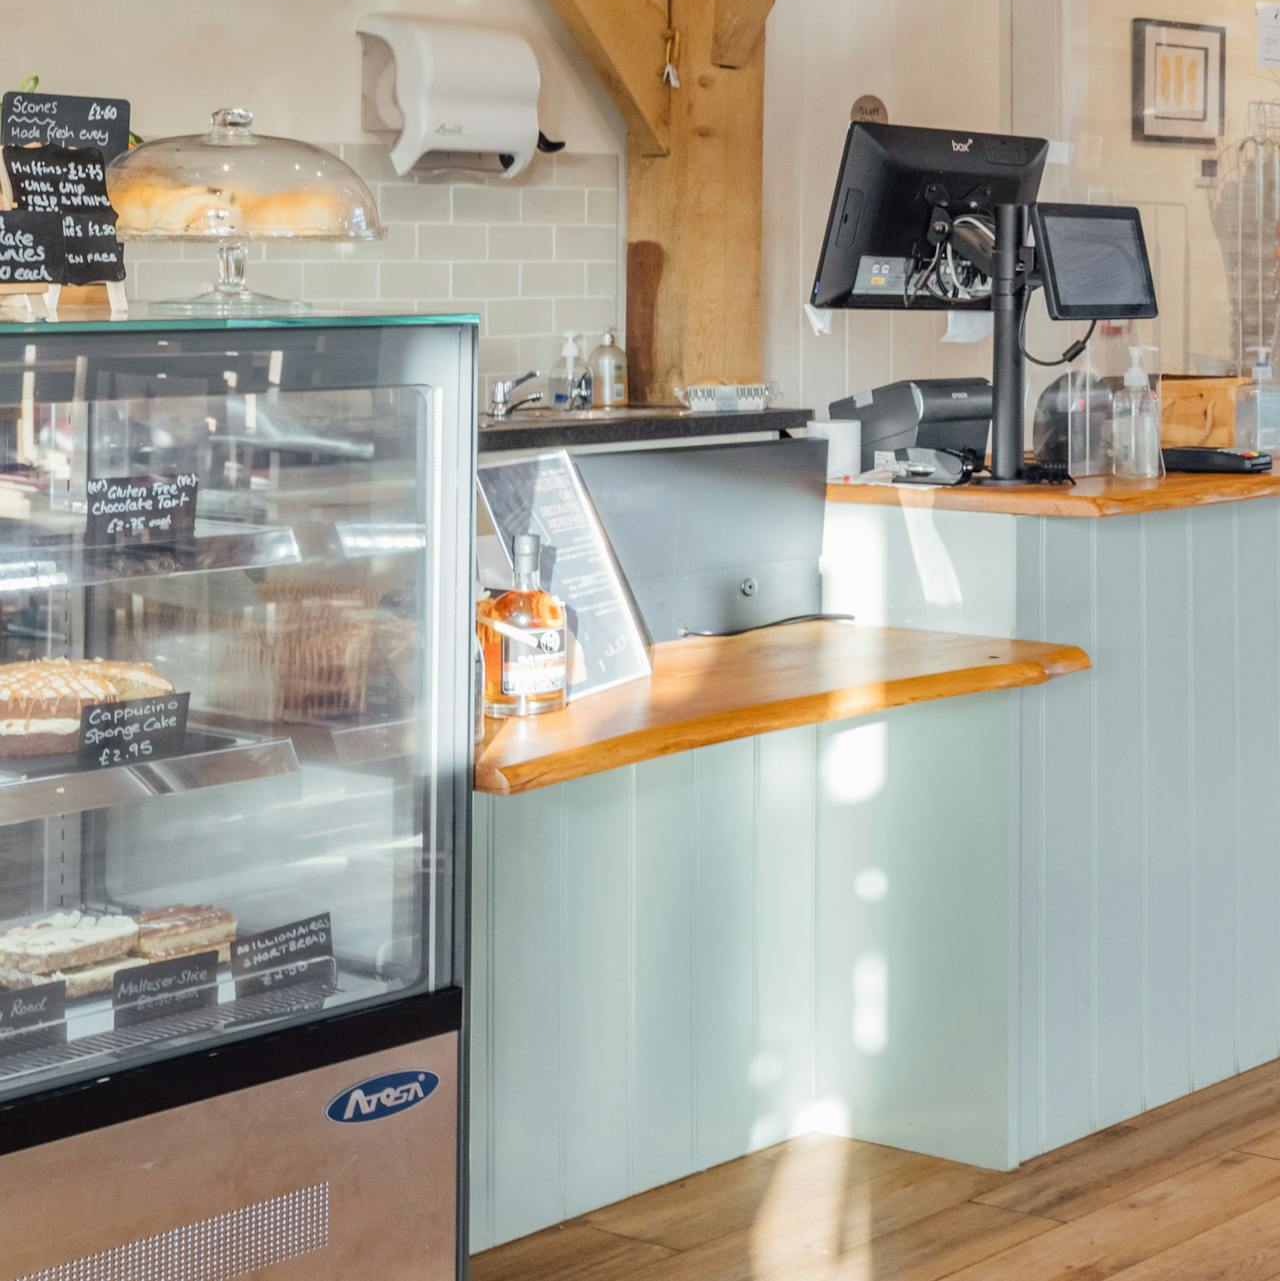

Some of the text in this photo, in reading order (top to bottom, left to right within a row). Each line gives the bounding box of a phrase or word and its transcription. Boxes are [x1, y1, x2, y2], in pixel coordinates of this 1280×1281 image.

[12, 95, 58, 114] Scones
[11, 123, 109, 146] Made fresh every
[14, 264, 53, 281] each
[107, 484, 147, 500] Gluten
[152, 481, 178, 496] Free
[92, 492, 189, 516] Chocolate Tart
[89, 700, 178, 725] Cappucino
[84, 715, 177, 745] Sponge Cake
[98, 739, 153, 767] £2.95
